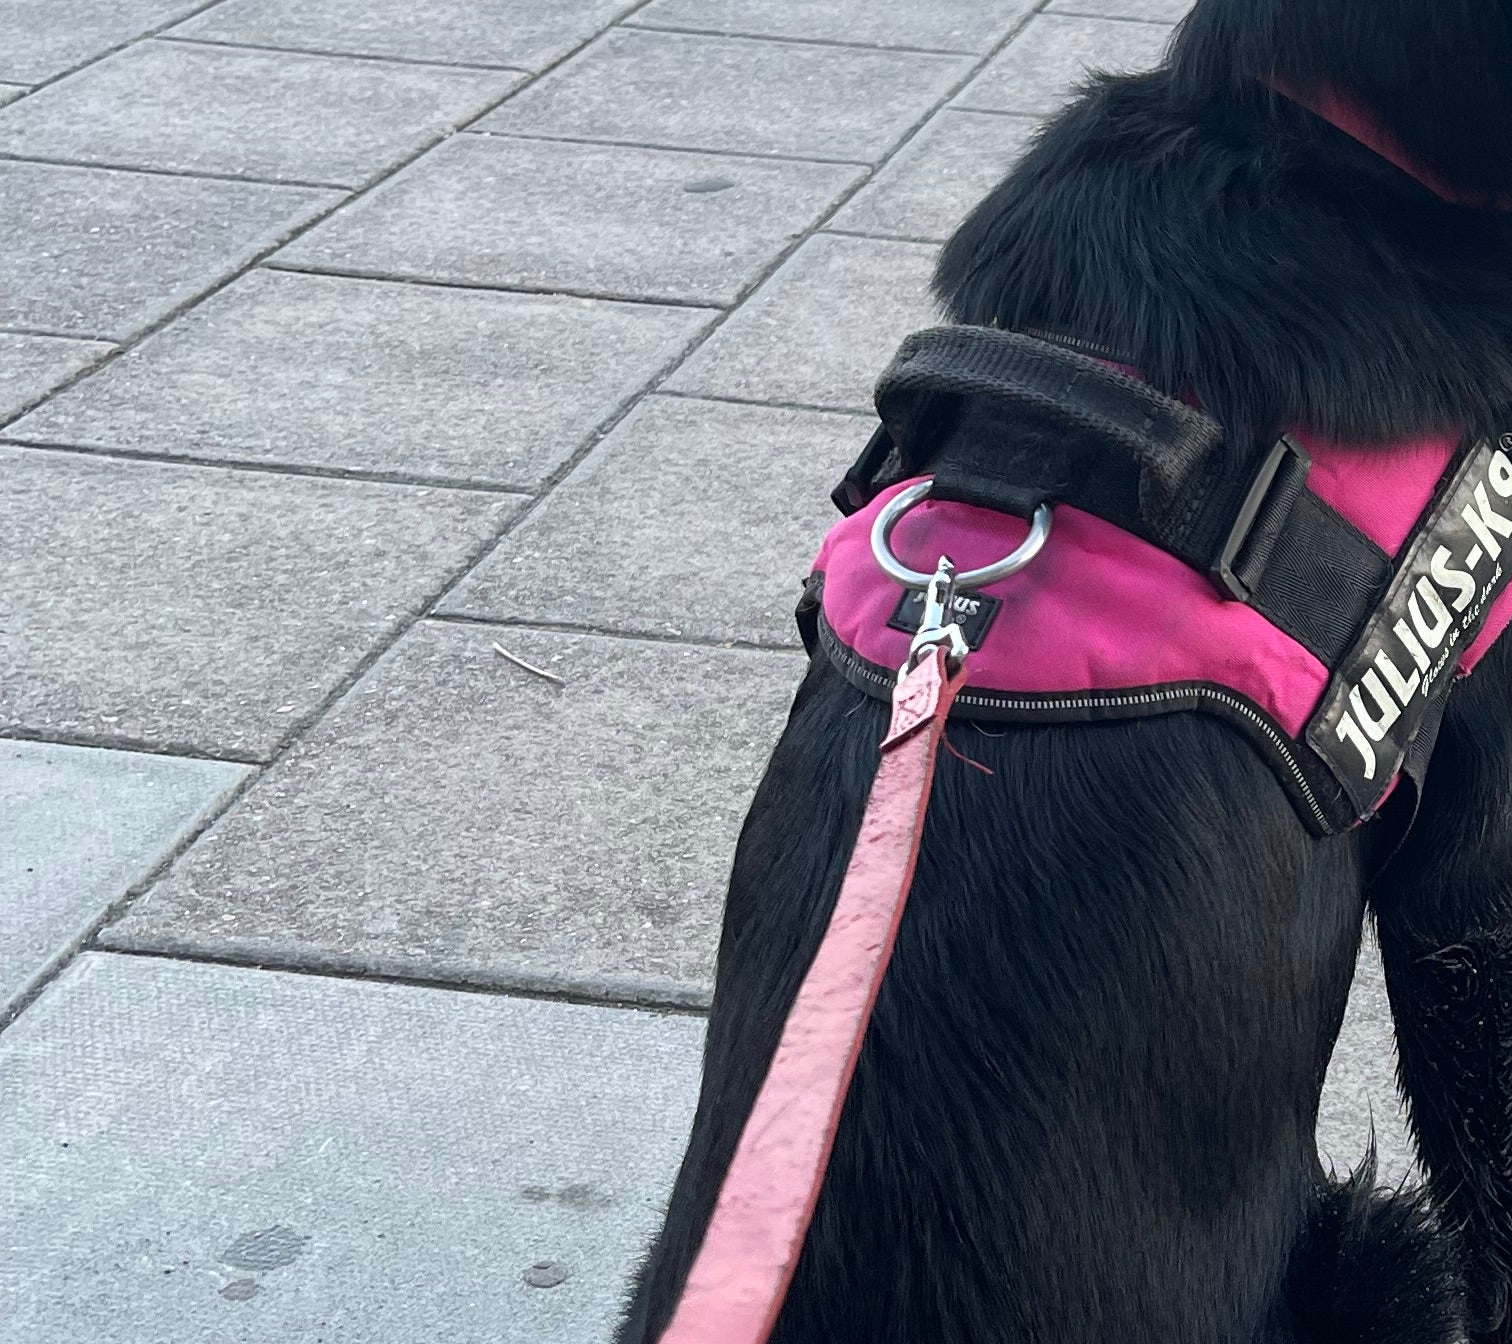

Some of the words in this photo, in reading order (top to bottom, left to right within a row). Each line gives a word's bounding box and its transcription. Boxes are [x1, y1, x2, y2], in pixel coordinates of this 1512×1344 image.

[1449, 627, 1460, 647] in
[1462, 605, 1481, 629] the
[1481, 562, 1502, 604] dark
